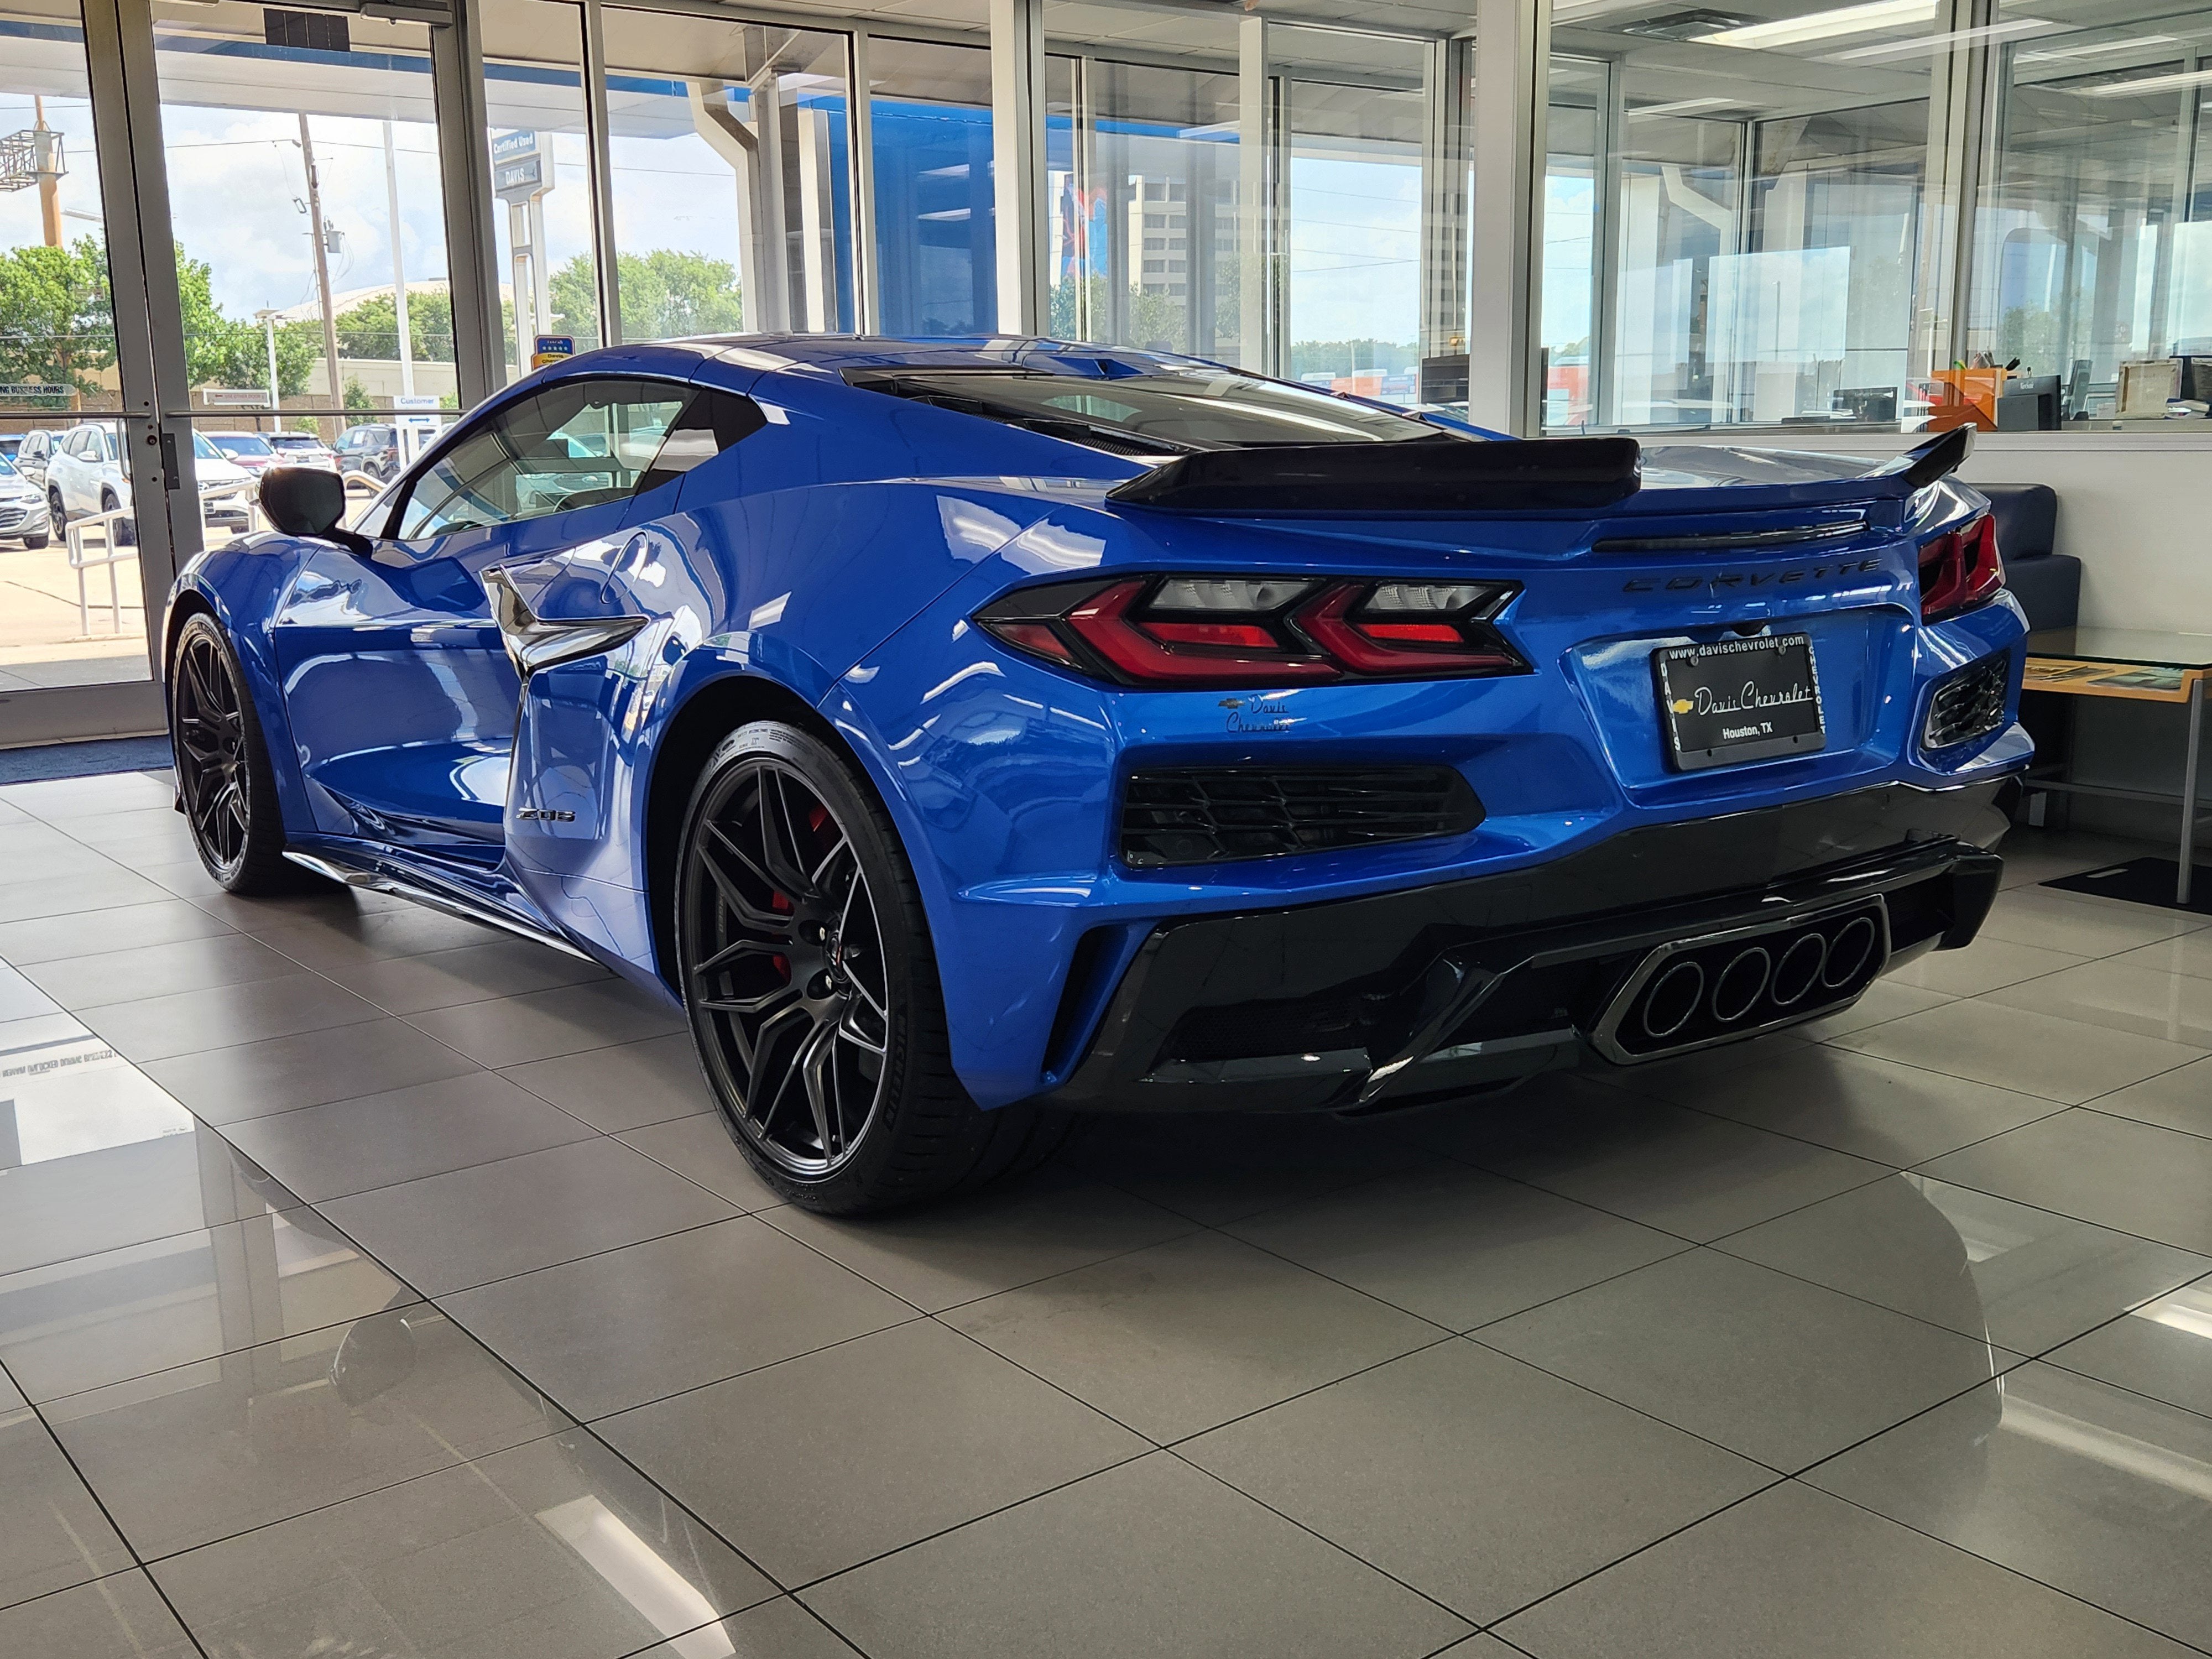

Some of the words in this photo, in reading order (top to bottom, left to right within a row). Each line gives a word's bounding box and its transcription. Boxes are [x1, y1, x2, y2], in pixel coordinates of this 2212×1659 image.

[494, 138, 518, 154] Certified
[518, 133, 533, 147] Used
[505, 168, 524, 185] DAVIS
[1623, 558, 1882, 593] CORVETTE
[1669, 635, 1804, 660] www.davischevroletcom
[1694, 686, 1741, 716] Davis
[1741, 681, 1813, 709] Chevrolet
[1808, 646, 1826, 734] CHEVROLET
[1248, 693, 1289, 714] Davis
[1660, 662, 1681, 751] DAVIS
[1723, 725, 1760, 739] Houston,
[1760, 722, 1773, 733] TX
[516, 807, 576, 822] Z06
[885, 1014, 907, 1124] MICHELIN
